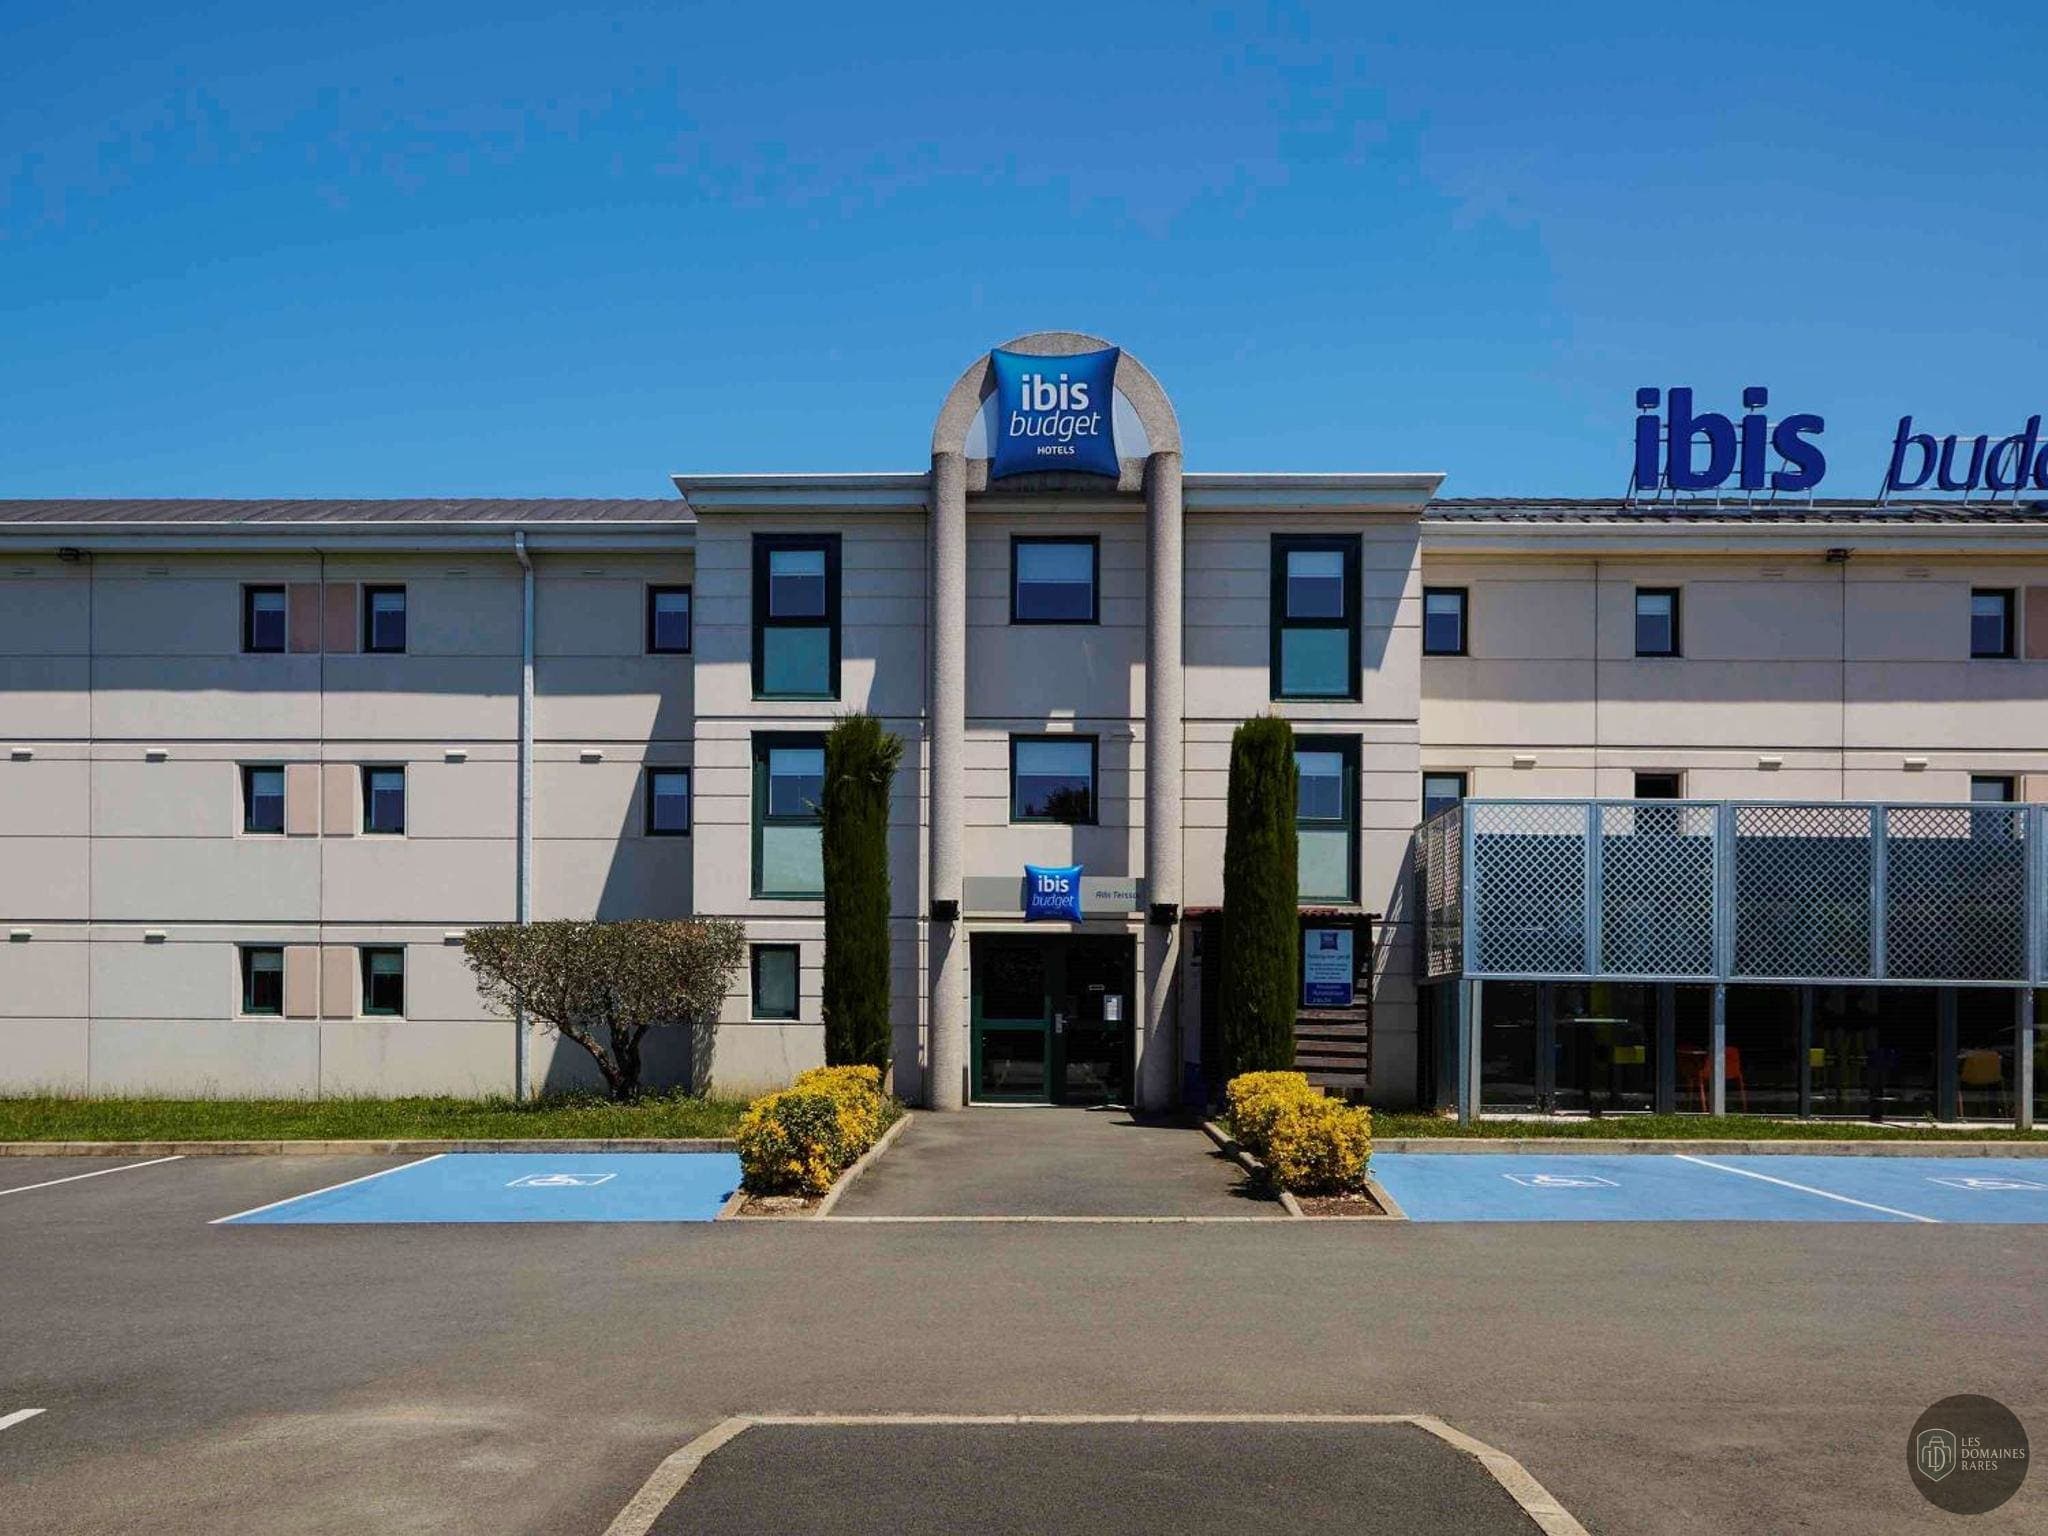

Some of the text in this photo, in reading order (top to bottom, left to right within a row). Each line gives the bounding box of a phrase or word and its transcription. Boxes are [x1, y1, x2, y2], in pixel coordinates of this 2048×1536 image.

[1021, 373, 1090, 412] ibis
[1009, 410, 1102, 442] budget
[1635, 386, 1827, 491] ibis
[1037, 445, 1076, 455] HOTELS
[1037, 875, 1070, 893] ibis
[1031, 893, 1075, 909] budget
